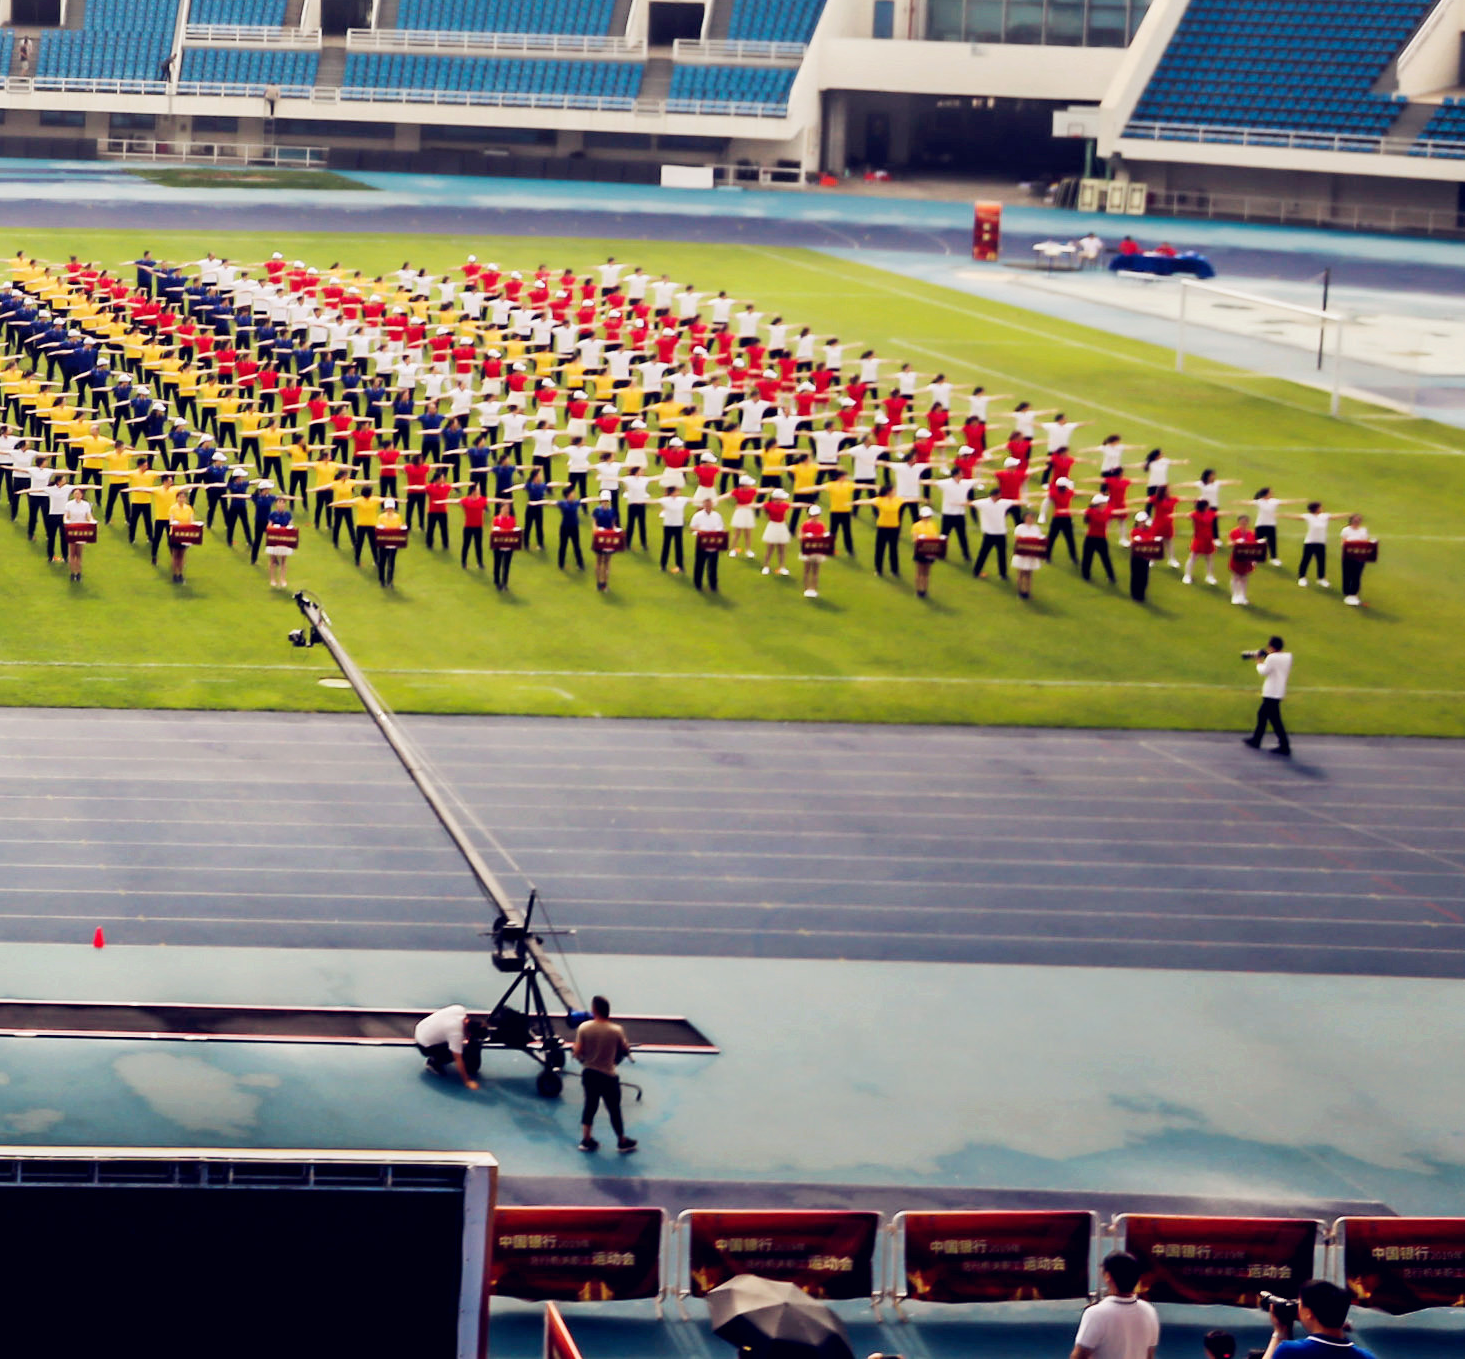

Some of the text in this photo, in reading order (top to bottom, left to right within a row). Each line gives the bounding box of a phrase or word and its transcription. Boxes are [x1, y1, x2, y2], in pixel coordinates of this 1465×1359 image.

[498, 1234, 557, 1249] 中国银行
[714, 1238, 773, 1252] 中国银行
[930, 1239, 988, 1254] 中国银行
[1151, 1244, 1212, 1260] 中国银行
[1372, 1246, 1430, 1261] 中国银行
